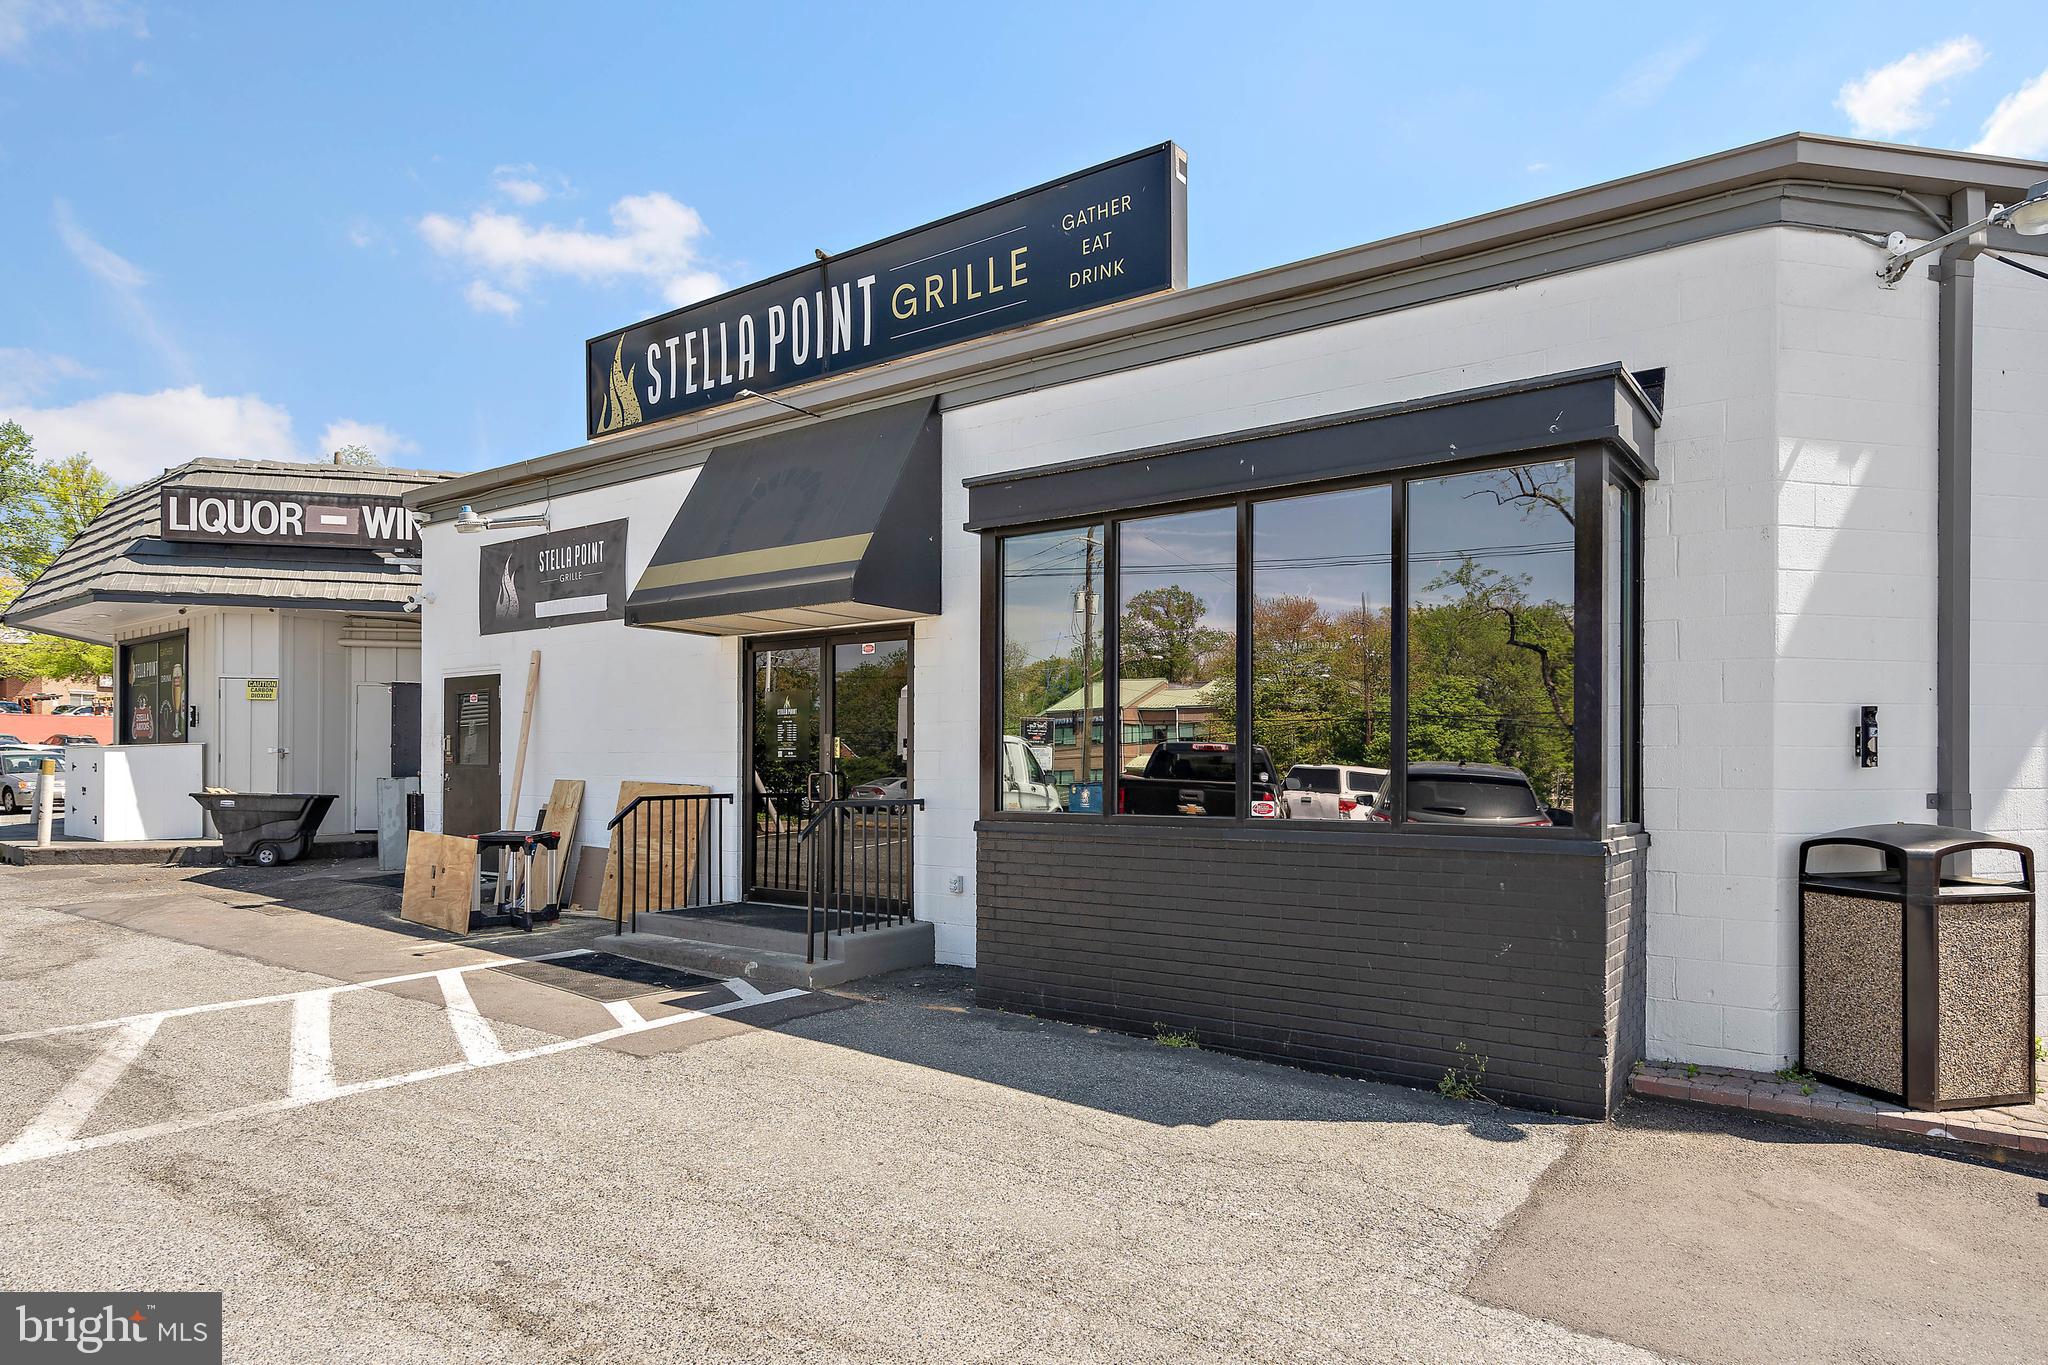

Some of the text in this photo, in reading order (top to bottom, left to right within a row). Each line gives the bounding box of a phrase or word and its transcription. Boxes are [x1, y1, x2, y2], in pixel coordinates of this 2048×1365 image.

[1062, 195, 1132, 231] GATHER
[1082, 231, 1113, 256] EAT
[1069, 258, 1125, 289] DRINK
[647, 246, 1028, 405] STELLA POINT GRILLE
[169, 496, 303, 536] LIQUOR
[539, 540, 605, 573] STELLA POINT
[559, 571, 583, 583] GRILLE
